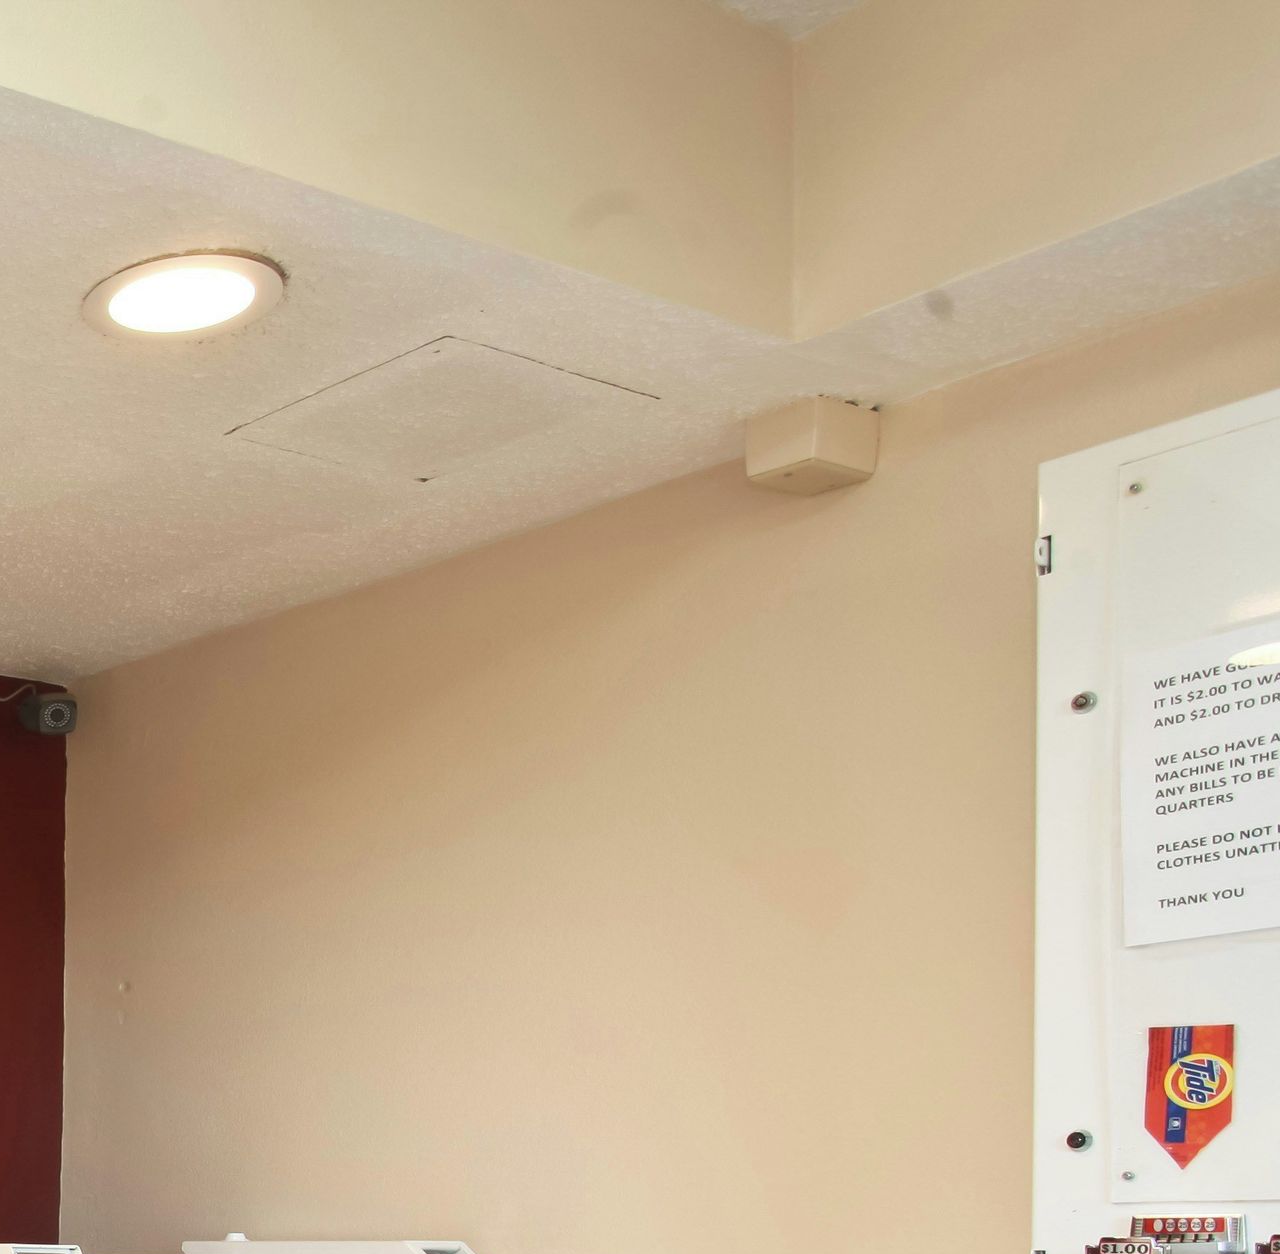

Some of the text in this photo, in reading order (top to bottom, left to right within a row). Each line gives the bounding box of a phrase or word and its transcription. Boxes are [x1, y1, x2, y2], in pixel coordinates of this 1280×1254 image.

[1154, 676, 1176, 690] WE
[1181, 666, 1221, 683] HAVE
[1154, 698, 1166, 709] IT
[1170, 694, 1182, 705] IS
[1187, 684, 1227, 703] $2.00
[1232, 679, 1252, 691] TO
[1154, 713, 1185, 728] AND
[1190, 703, 1230, 721] $2.00
[1235, 698, 1255, 710] TO
[1154, 754, 1178, 767] WE
[1182, 745, 1219, 761] ALSO
[1225, 736, 1265, 753] HAVE
[1155, 750, 1279, 783] MACHINE IN THE
[1155, 768, 1275, 799] ANY BILLS TO BE
[1155, 792, 1234, 815] QUARTERS
[1156, 836, 1207, 854] PLEASE
[1212, 832, 1234, 845] DO
[1239, 825, 1272, 840] NOT
[1157, 841, 1280, 870] CLOTHES UNATT
[1158, 887, 1245, 909] THANK YOU
[1178, 1058, 1216, 1104] Tide
[1100, 1243, 1149, 1254] $1.00
